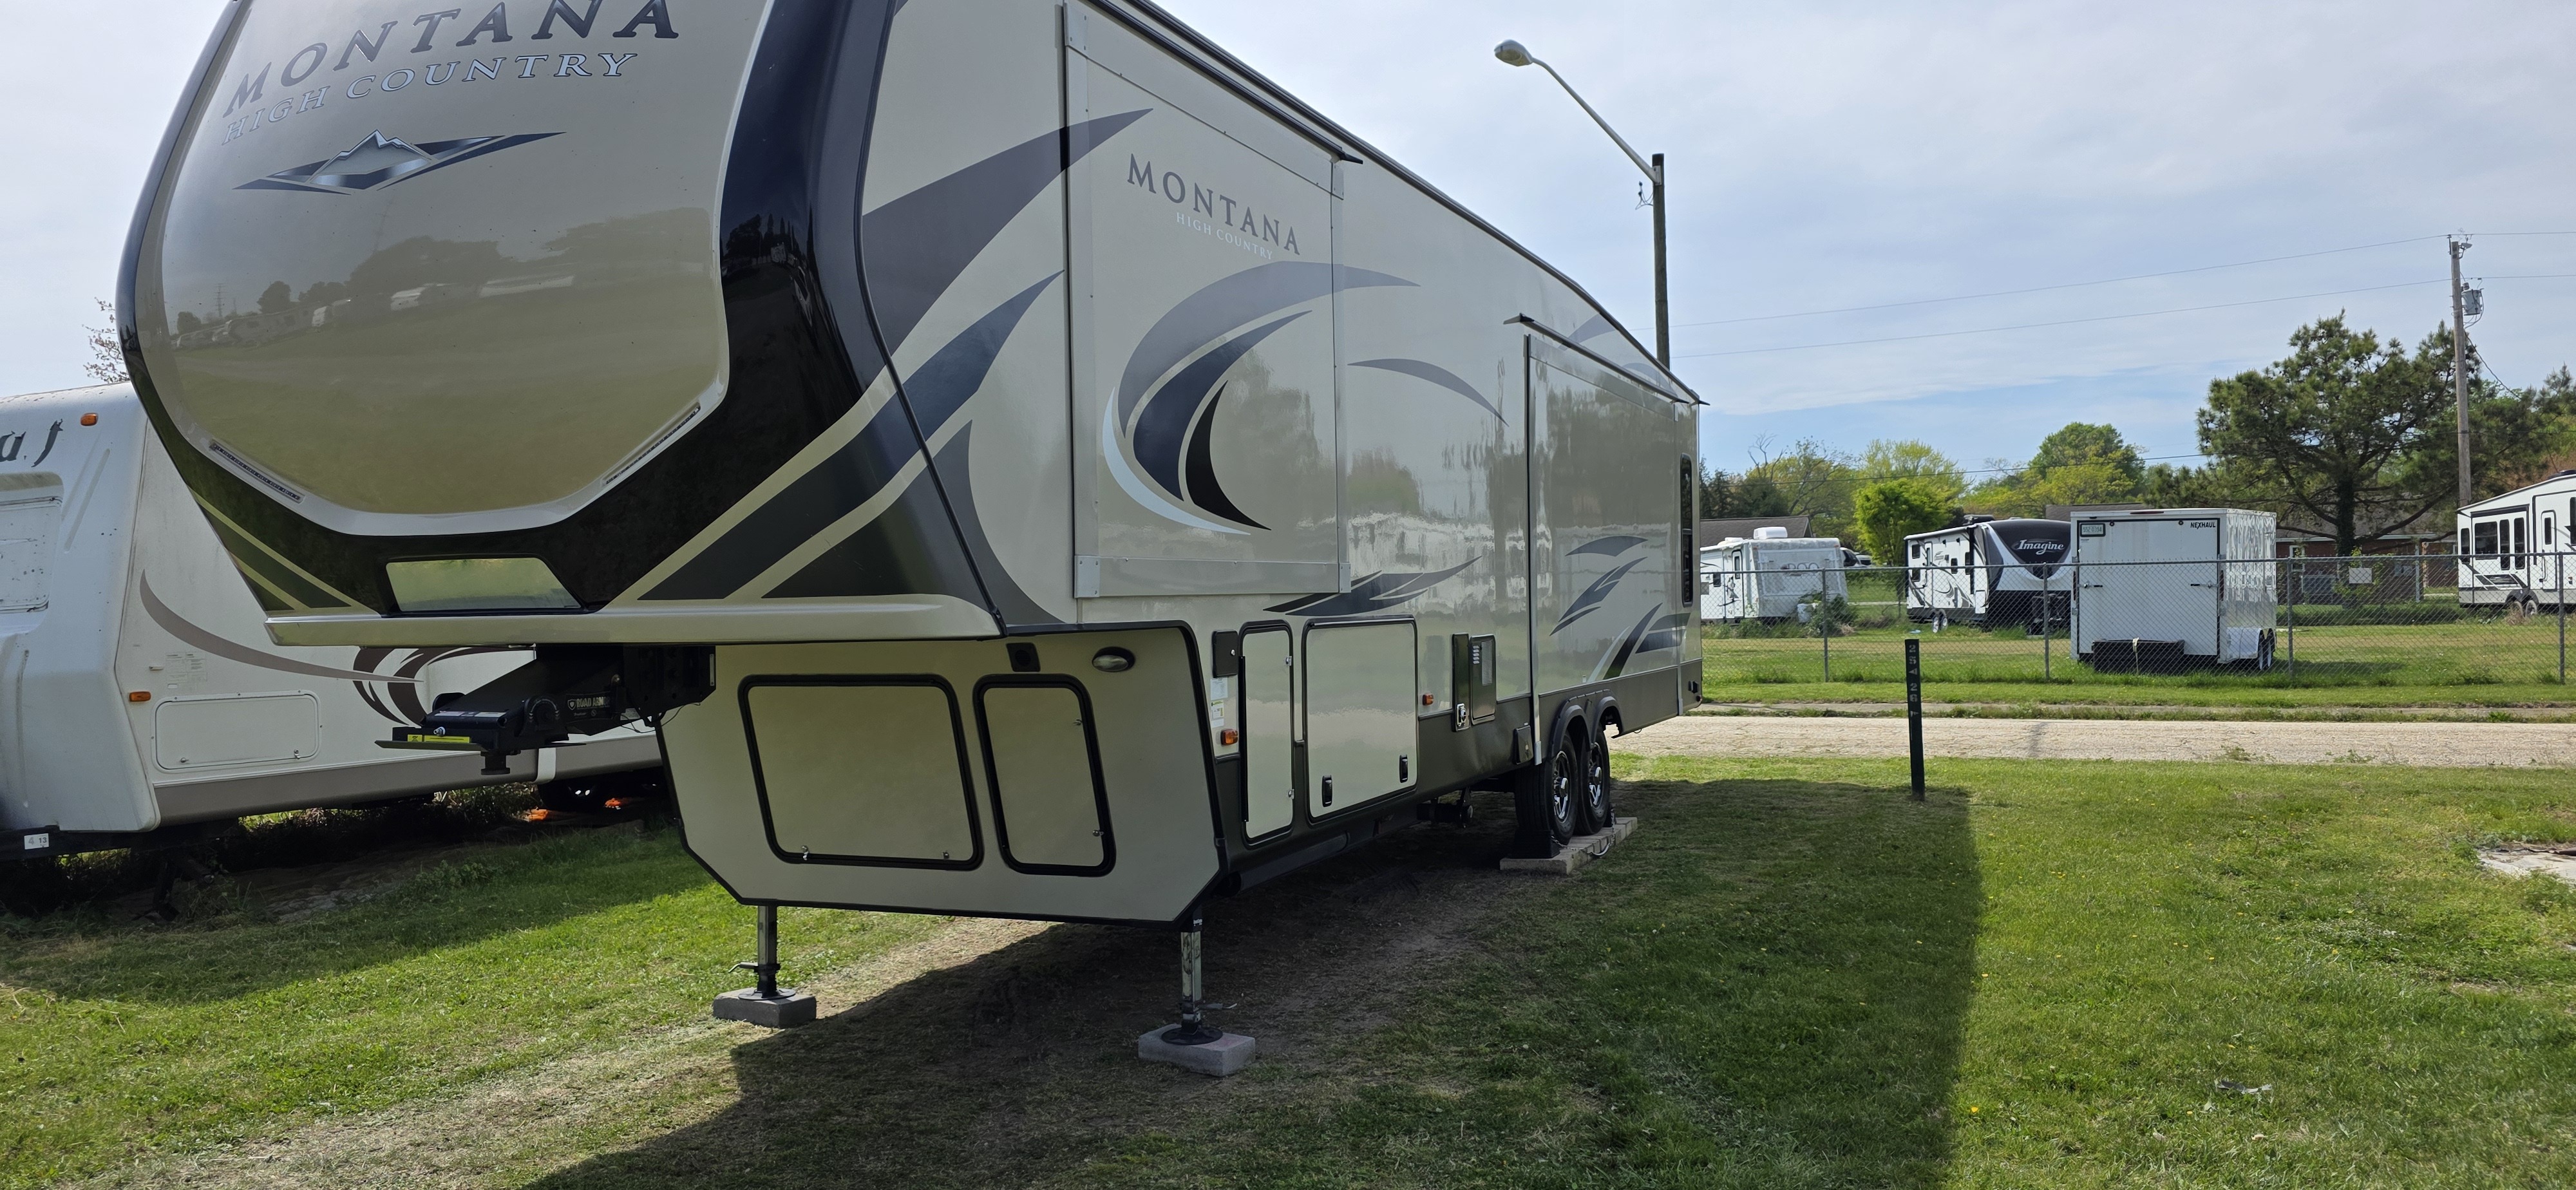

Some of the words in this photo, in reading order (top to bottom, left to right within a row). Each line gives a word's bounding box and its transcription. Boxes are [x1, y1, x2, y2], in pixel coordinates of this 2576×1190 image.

[222, 86, 330, 146] HIGH
[346, 53, 638, 99] COUNTRY
[223, 0, 679, 118] MONTANA
[1127, 153, 1300, 256] MONTANA
[1176, 212, 1211, 235] HIGH
[1217, 229, 1273, 260] COUNTRY
[2017, 539, 2065, 555] Imagine
